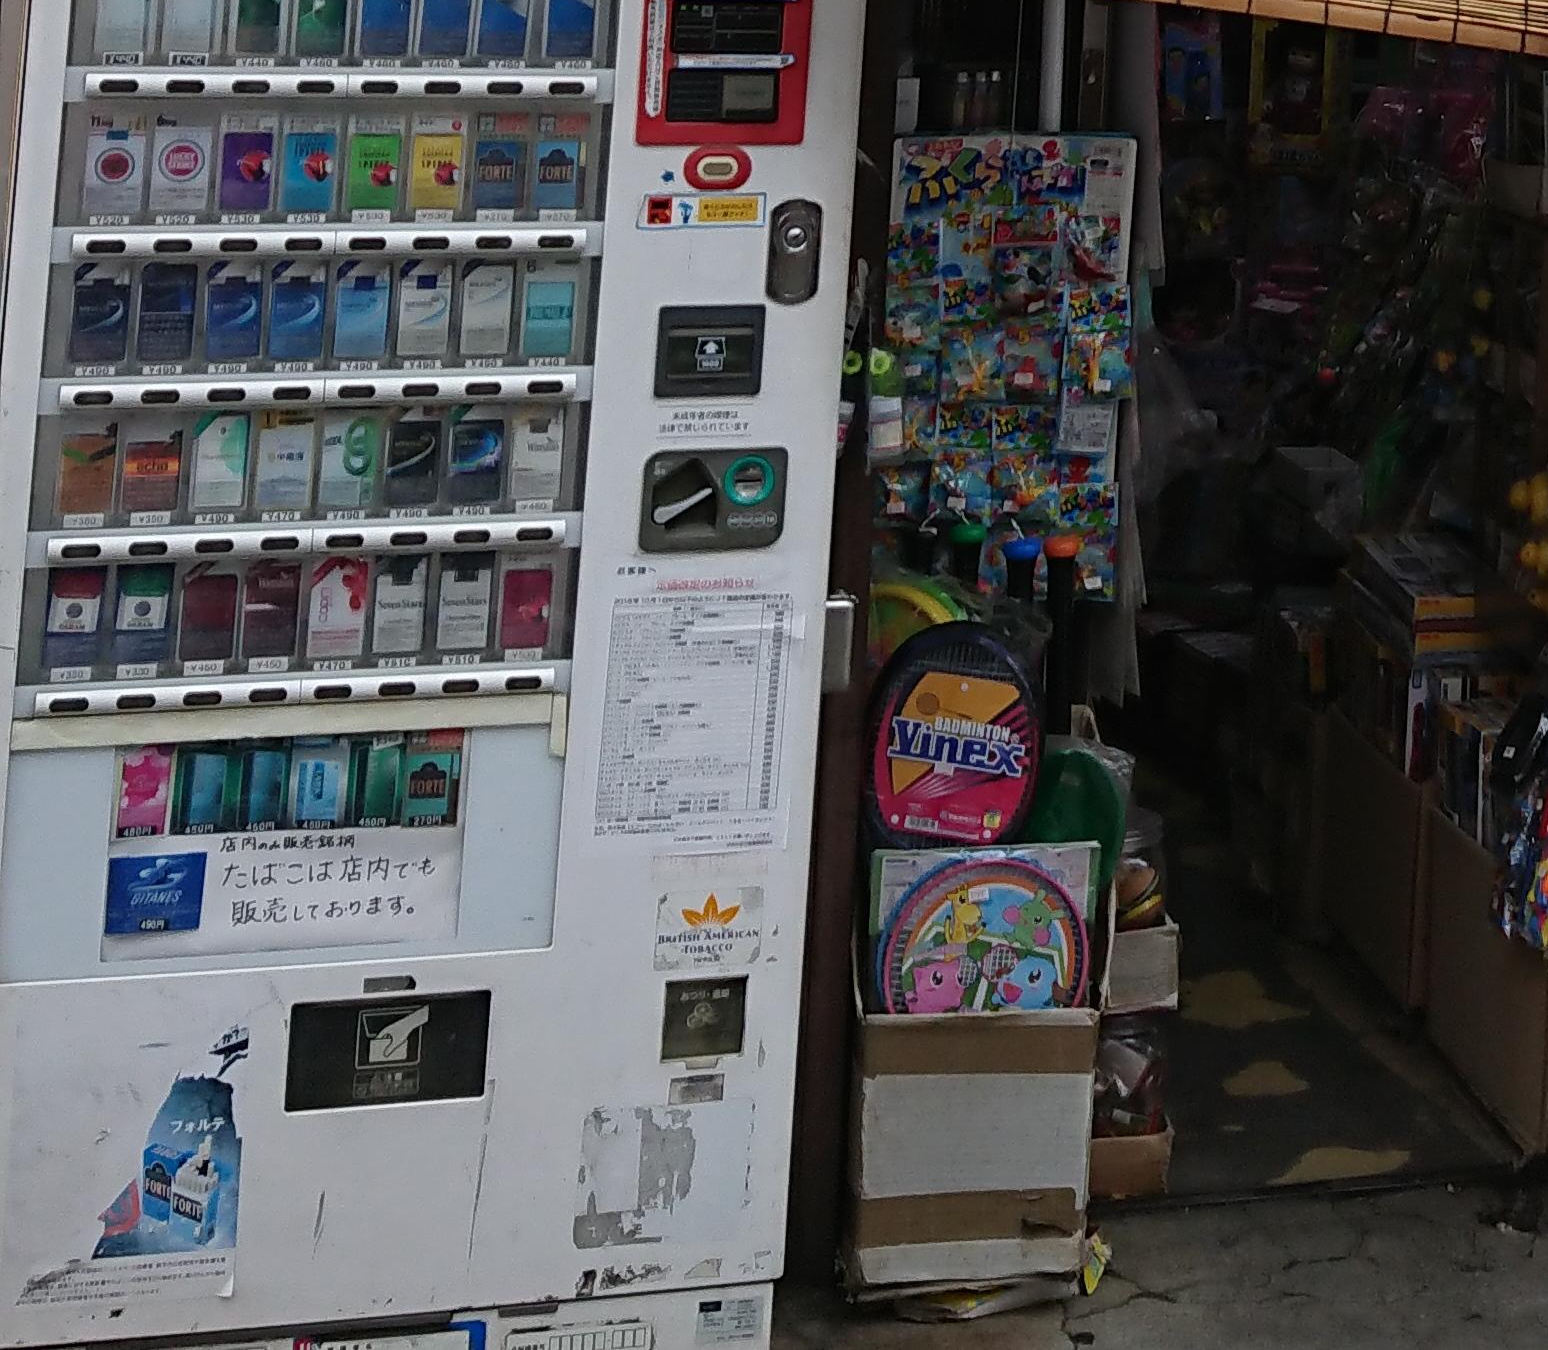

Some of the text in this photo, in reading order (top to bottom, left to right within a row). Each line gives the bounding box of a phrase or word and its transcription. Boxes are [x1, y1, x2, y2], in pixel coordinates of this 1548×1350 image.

[478, 165, 513, 180] FORTE
[539, 164, 573, 180] FORTE
[136, 460, 169, 473] echo
[934, 716, 1011, 743] BADMINTON
[887, 715, 1026, 778] Vinex
[410, 778, 446, 796] FORTE
[221, 853, 437, 890] たばこは店内でも
[130, 888, 184, 907] GITANES
[231, 893, 416, 926] 販売しております。
[683, 943, 733, 955] TOBACCO
[169, 1116, 226, 1135] フォルテ
